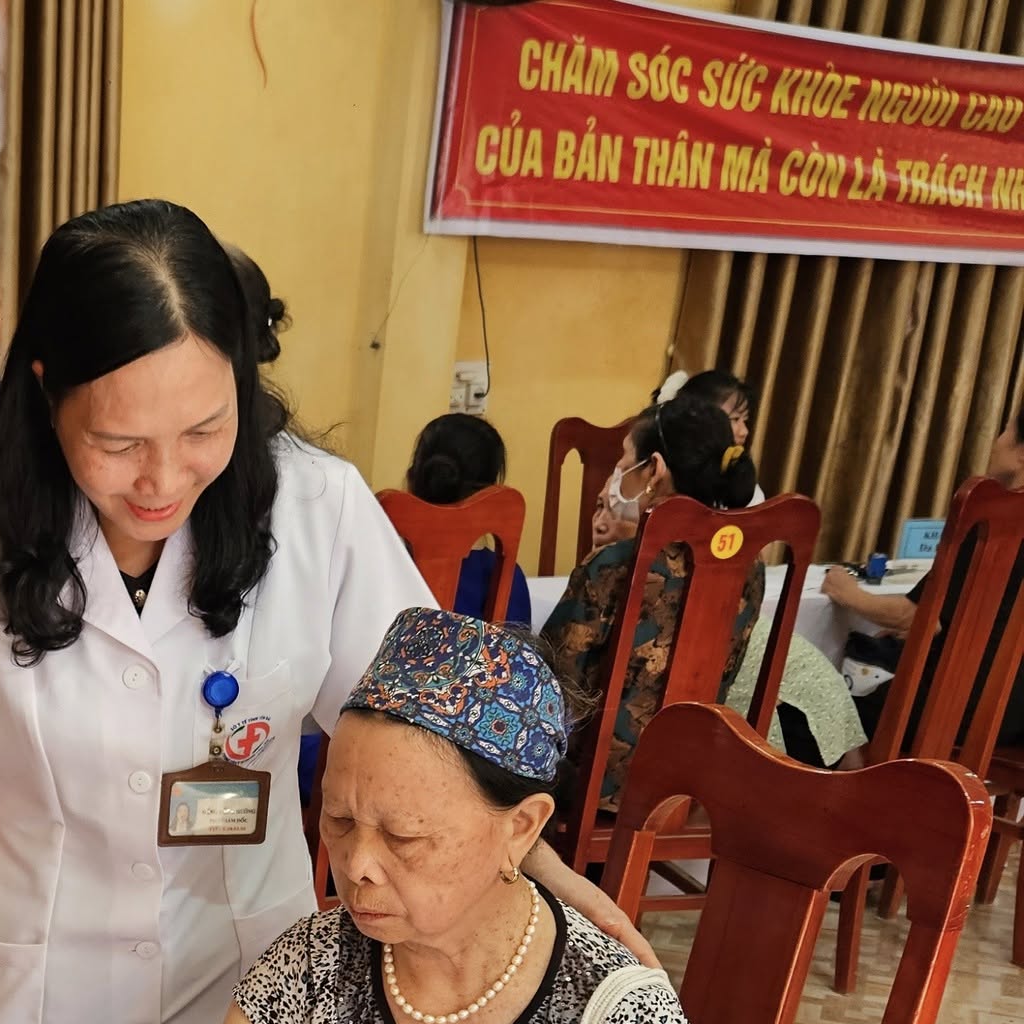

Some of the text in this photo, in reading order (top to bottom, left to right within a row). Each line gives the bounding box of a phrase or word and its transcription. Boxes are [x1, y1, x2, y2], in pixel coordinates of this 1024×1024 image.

[519, 35, 619, 97] CHĂM
[626, 45, 692, 104] SÓC
[699, 53, 769, 112] SỨC
[770, 62, 861, 119] KHỎE
[961, 92, 1024, 133] CAO
[475, 110, 543, 178] CỦA
[553, 116, 623, 183] BẢN
[632, 130, 714, 190] THÂN
[779, 141, 846, 198] CÒN
[848, 147, 887, 200] LÀ
[896, 153, 987, 208] TRÁCH
[717, 533, 736, 552] 51
